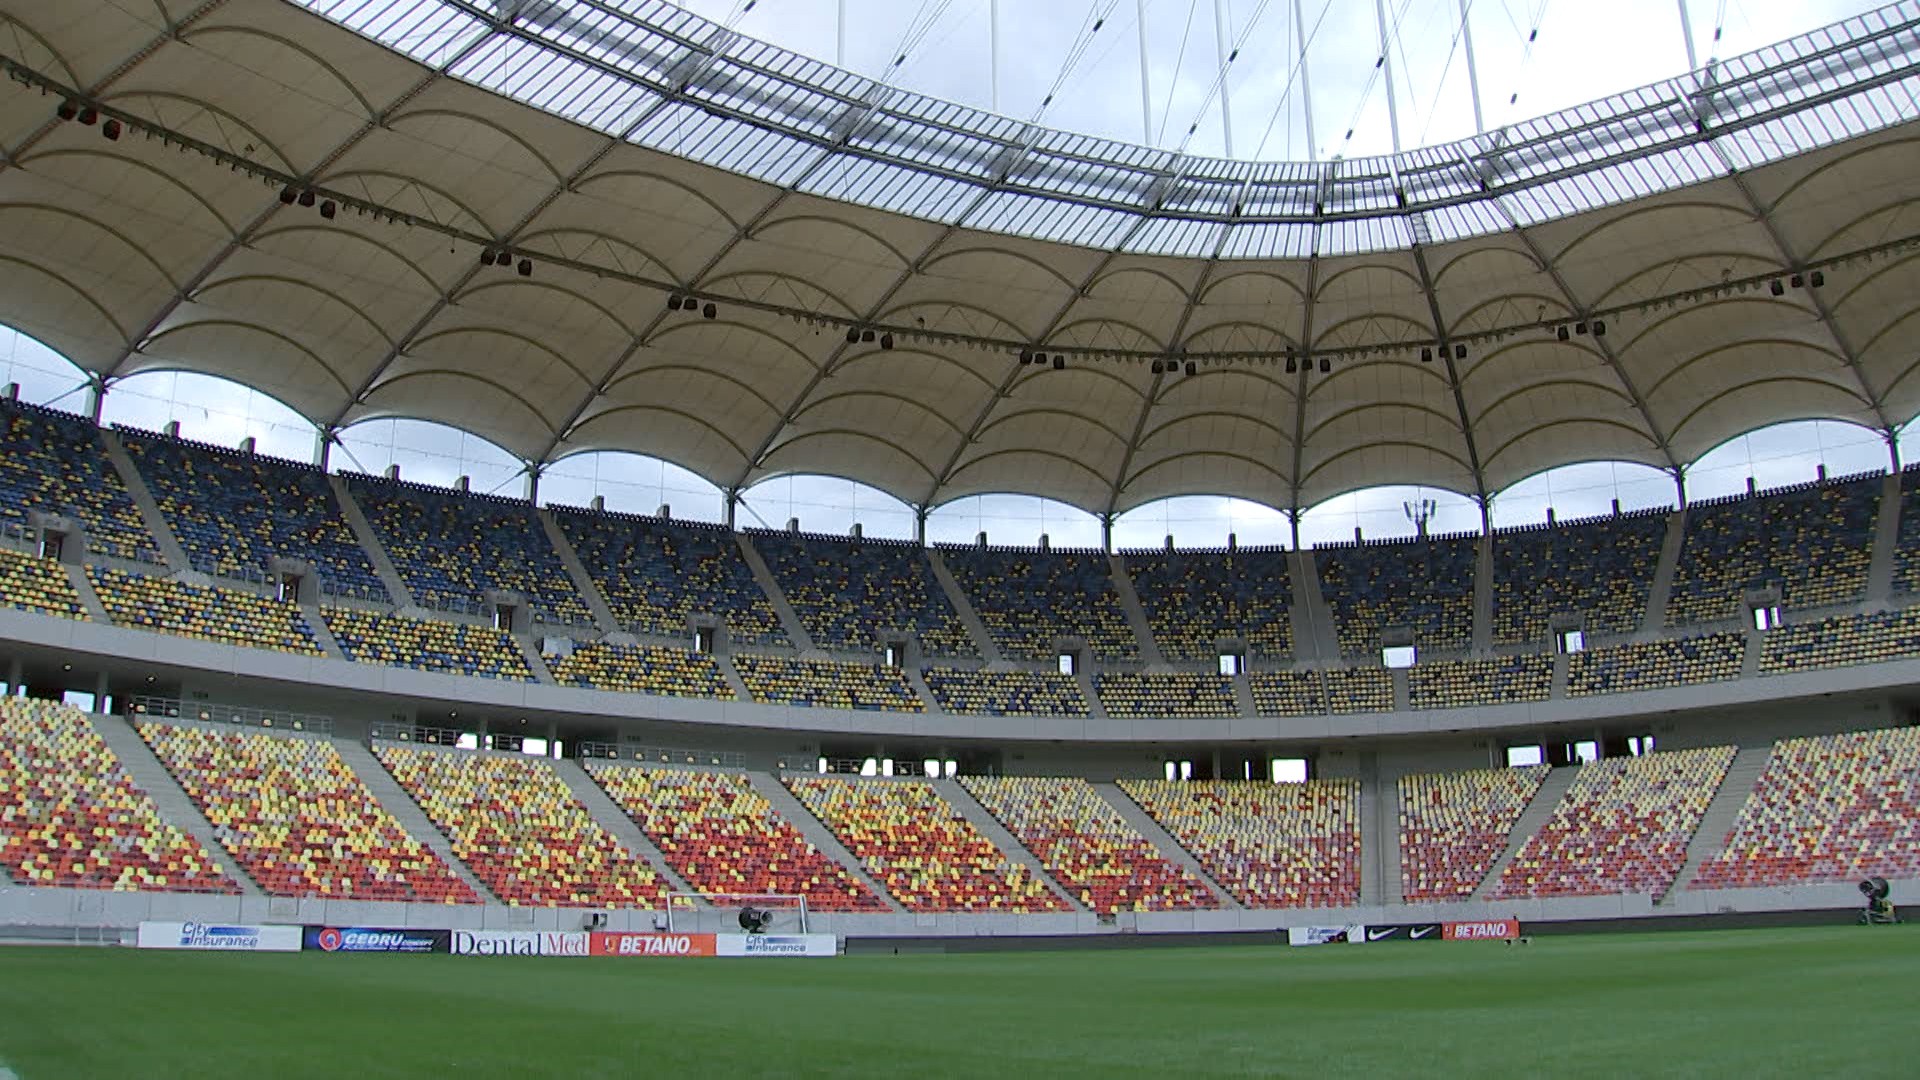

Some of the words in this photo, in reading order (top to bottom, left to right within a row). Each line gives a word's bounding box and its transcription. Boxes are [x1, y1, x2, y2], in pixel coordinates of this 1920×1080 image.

[182, 921, 209, 941] City
[1454, 923, 1507, 938] BETANO
[619, 936, 690, 954] BETANO
